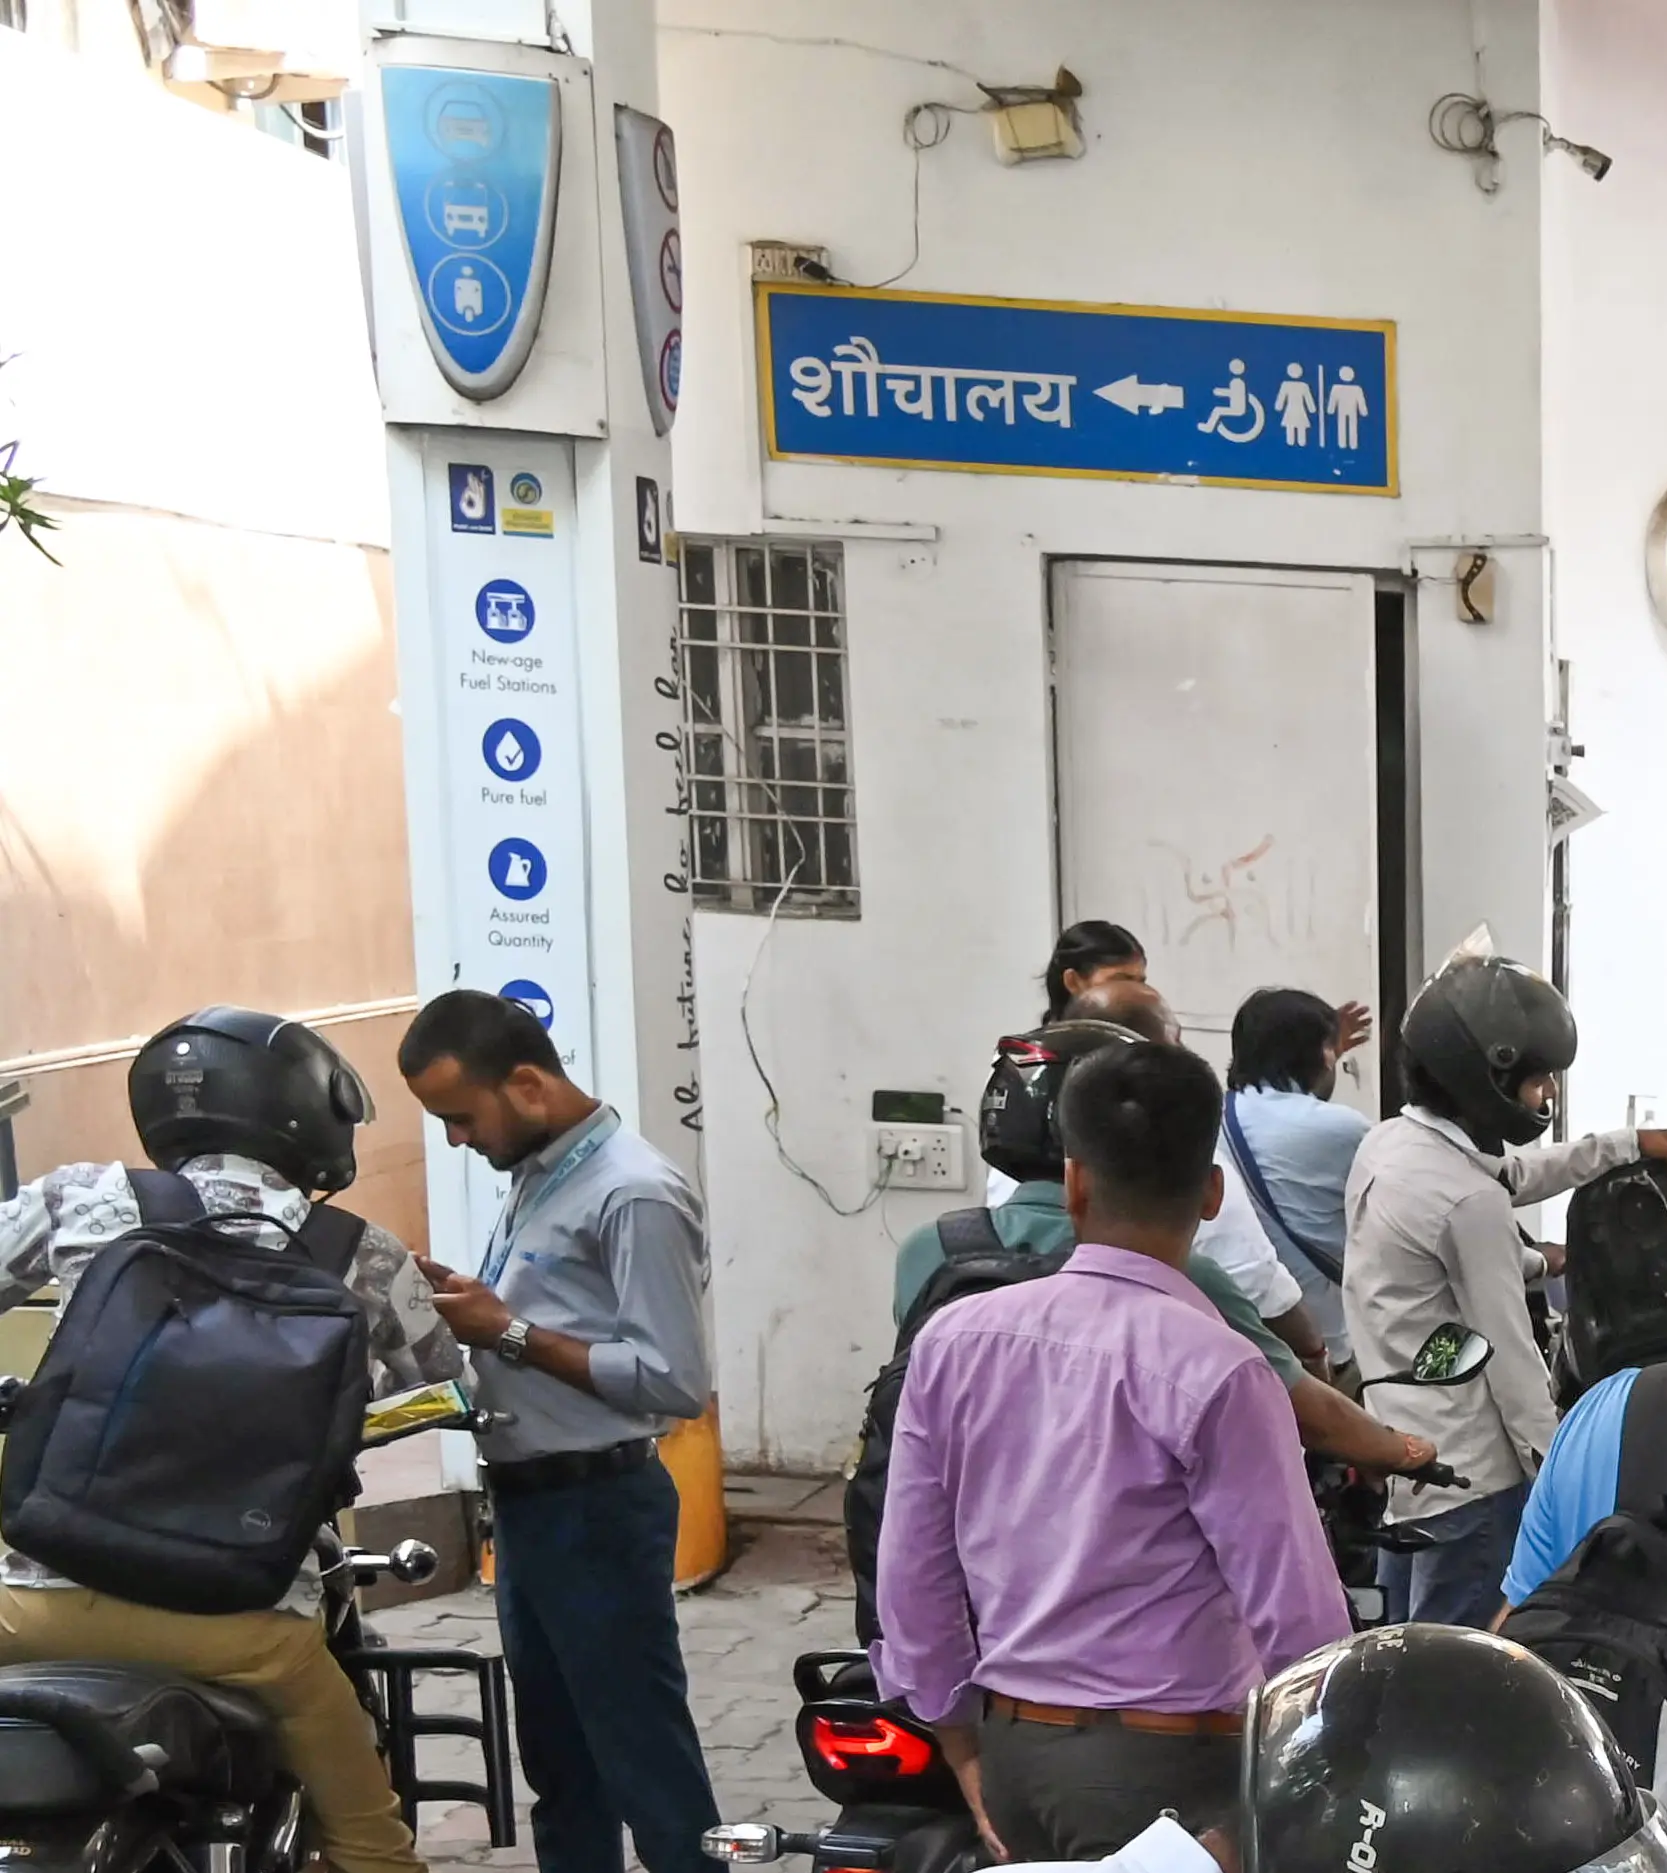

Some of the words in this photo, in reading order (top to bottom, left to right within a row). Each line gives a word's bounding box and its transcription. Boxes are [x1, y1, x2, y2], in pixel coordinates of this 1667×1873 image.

[789, 336, 1076, 429] शौचालय
[472, 650, 543, 671] New-age
[460, 673, 491, 690] Fuel
[496, 676, 557, 695] Stations
[481, 787, 514, 805] Pure
[520, 789, 547, 806] fuel
[489, 908, 550, 925] Assured
[488, 931, 553, 952] Quantity
